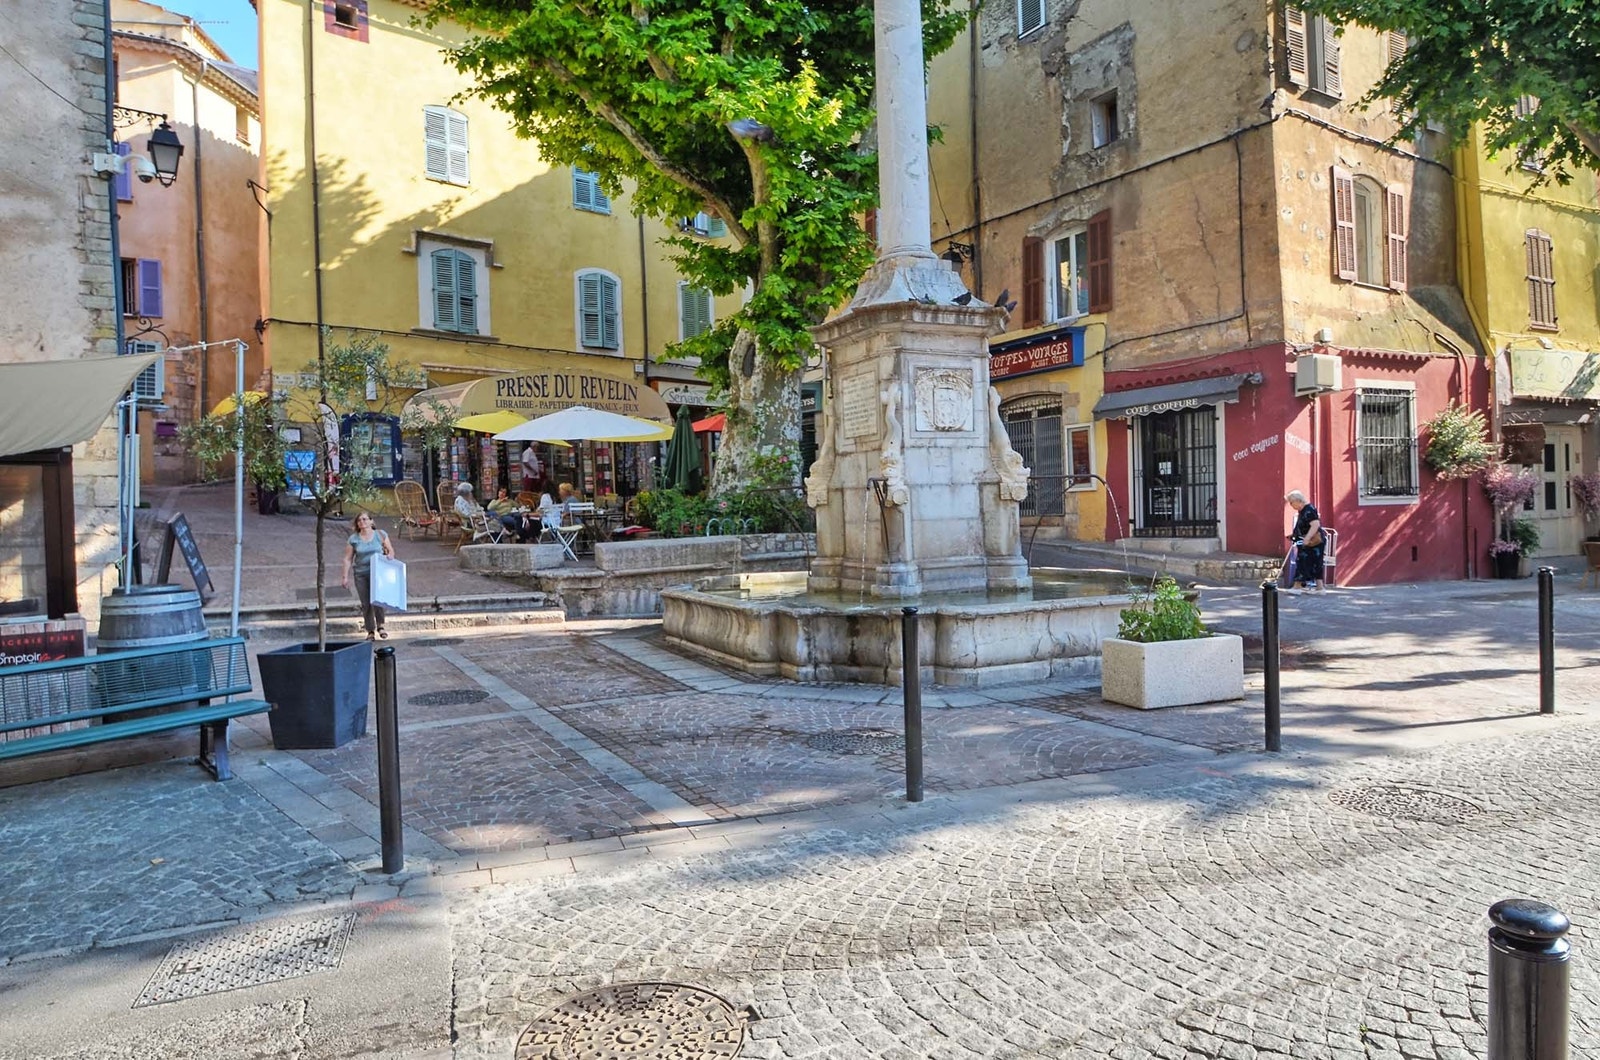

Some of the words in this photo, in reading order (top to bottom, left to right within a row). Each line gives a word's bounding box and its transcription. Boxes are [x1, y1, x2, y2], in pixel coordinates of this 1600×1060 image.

[1027, 341, 1069, 361] VOYAGES
[496, 373, 550, 399] PRESSE
[553, 373, 576, 399] DU
[580, 376, 639, 401] REVELIN
[669, 391, 704, 405] Servane
[1152, 398, 1198, 412] COIFFURE
[495, 399, 534, 409] LIBRAIRIE
[539, 399, 576, 410] PAPETERIE
[622, 402, 640, 413] JEUX
